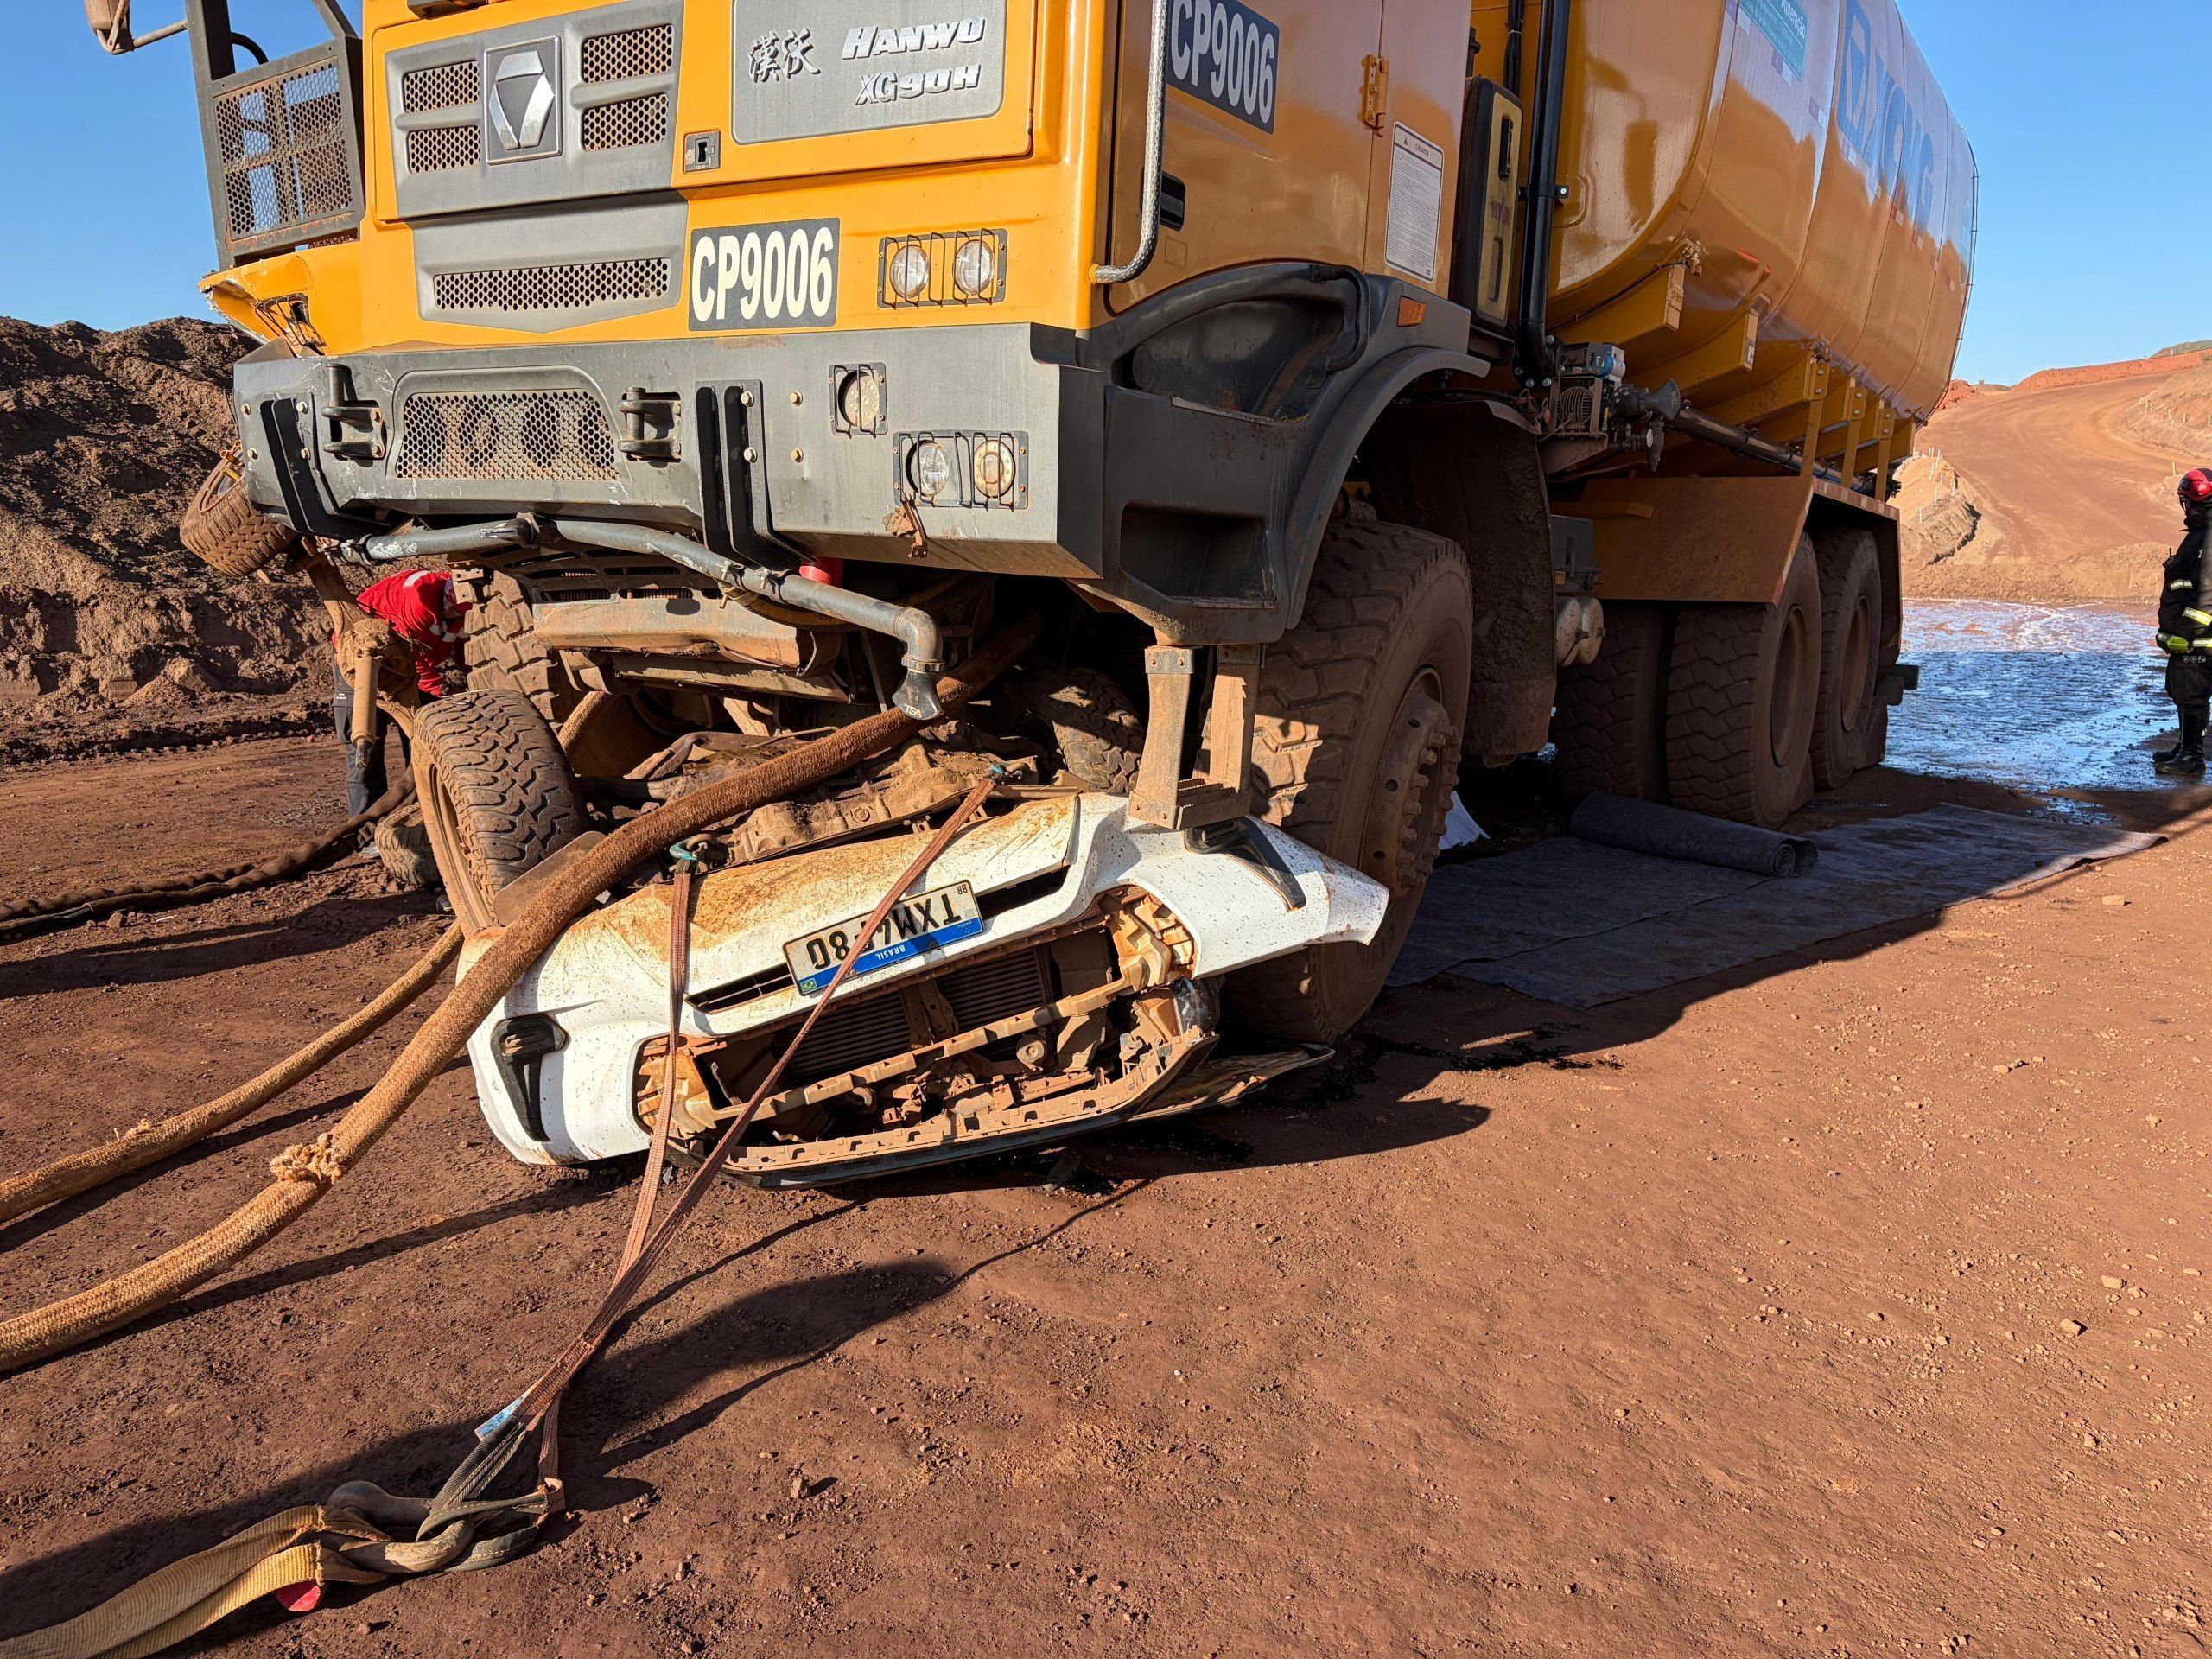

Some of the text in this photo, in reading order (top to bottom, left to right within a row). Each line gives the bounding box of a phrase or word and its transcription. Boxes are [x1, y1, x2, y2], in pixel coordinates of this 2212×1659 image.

[748, 27, 821, 84] 漢沃
[842, 17, 985, 60] HANWO
[1171, 0, 1274, 124] CP9006
[855, 64, 982, 105] XG90H
[691, 226, 834, 322] CP9006
[956, 883, 968, 895] BR
[874, 944, 906, 961] BRASIL
